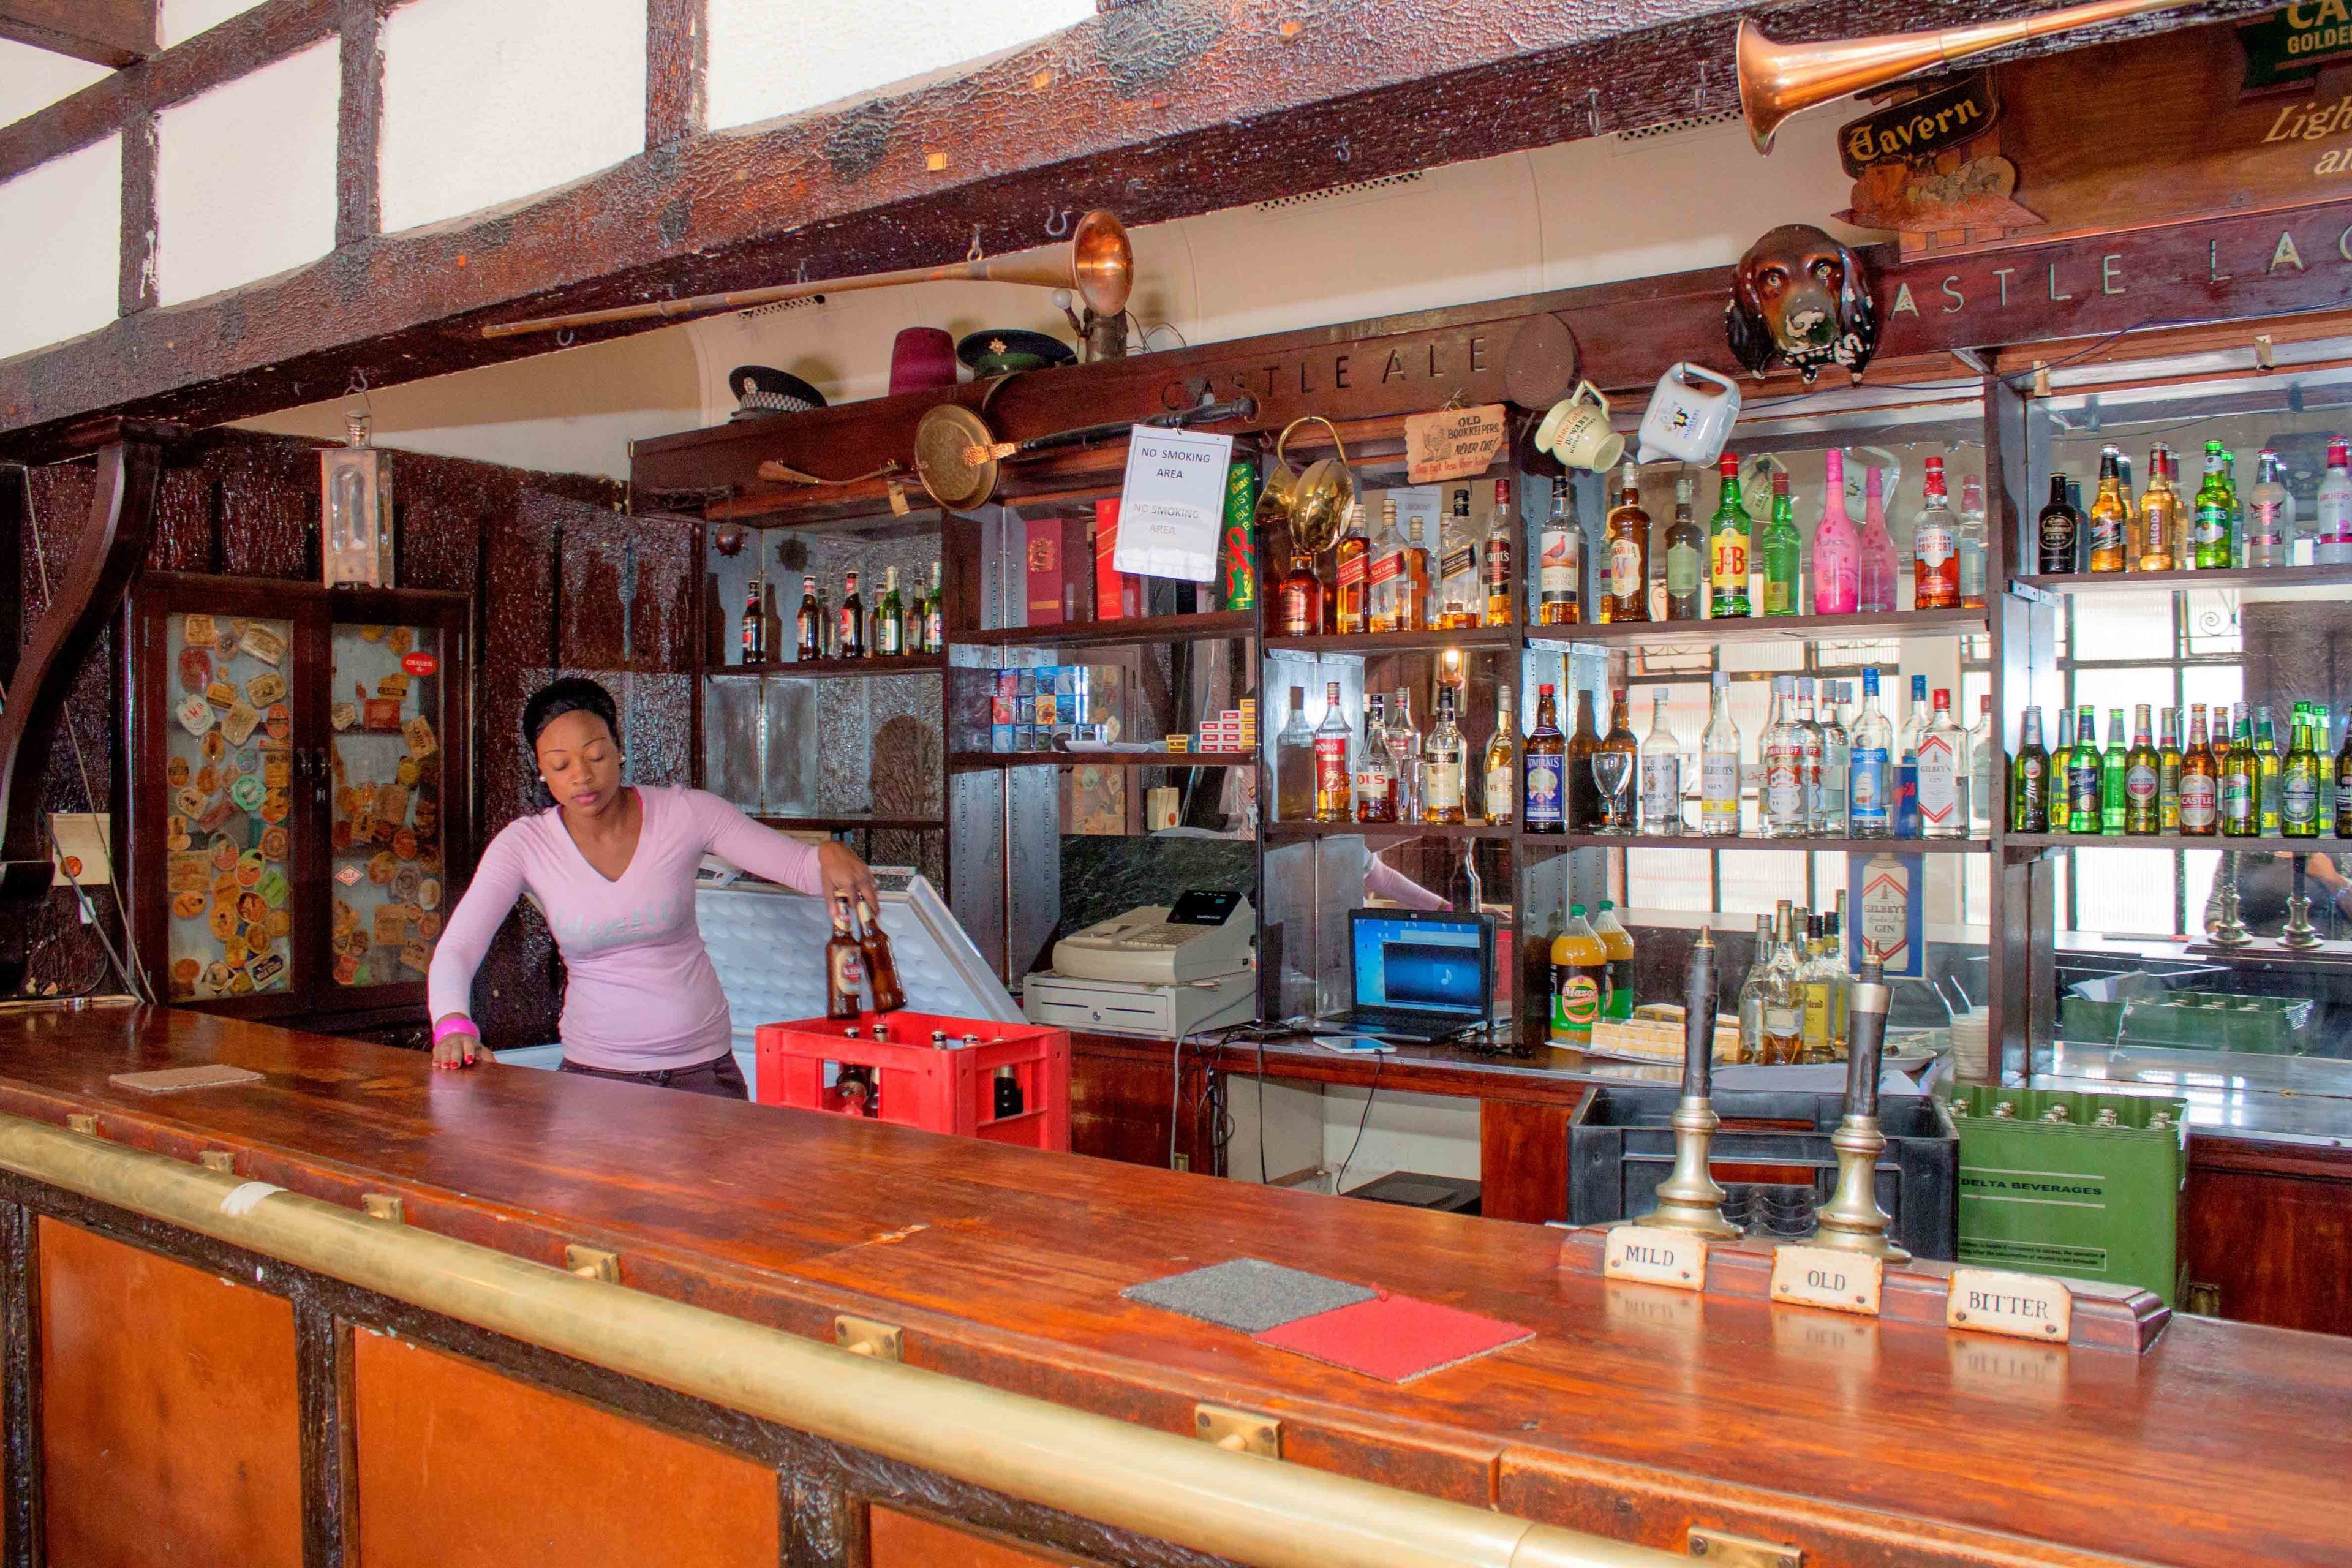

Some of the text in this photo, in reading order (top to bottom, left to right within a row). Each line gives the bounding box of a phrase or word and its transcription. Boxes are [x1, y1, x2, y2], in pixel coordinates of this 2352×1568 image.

[2286, 24, 2352, 54] GOLDE
[1847, 94, 1985, 162] Tavern
[1889, 255, 2128, 320] ASTLE
[1382, 337, 1487, 384] ALE
[1458, 415, 1481, 427] OLD
[1141, 448, 1211, 463] NO SMOKING
[1156, 468, 1183, 479] AREA
[1133, 503, 1200, 519] NO SMOKING
[1149, 524, 1176, 535] AREA
[1864, 904, 1907, 914] GILBEY'S
[1874, 924, 1896, 933] GIN
[1961, 1178, 2102, 1195] DELTA BEVERAGES
[1624, 1245, 1675, 1267] MILD
[1807, 1270, 1846, 1292] OLD
[1969, 1291, 2049, 1319] BITTER
